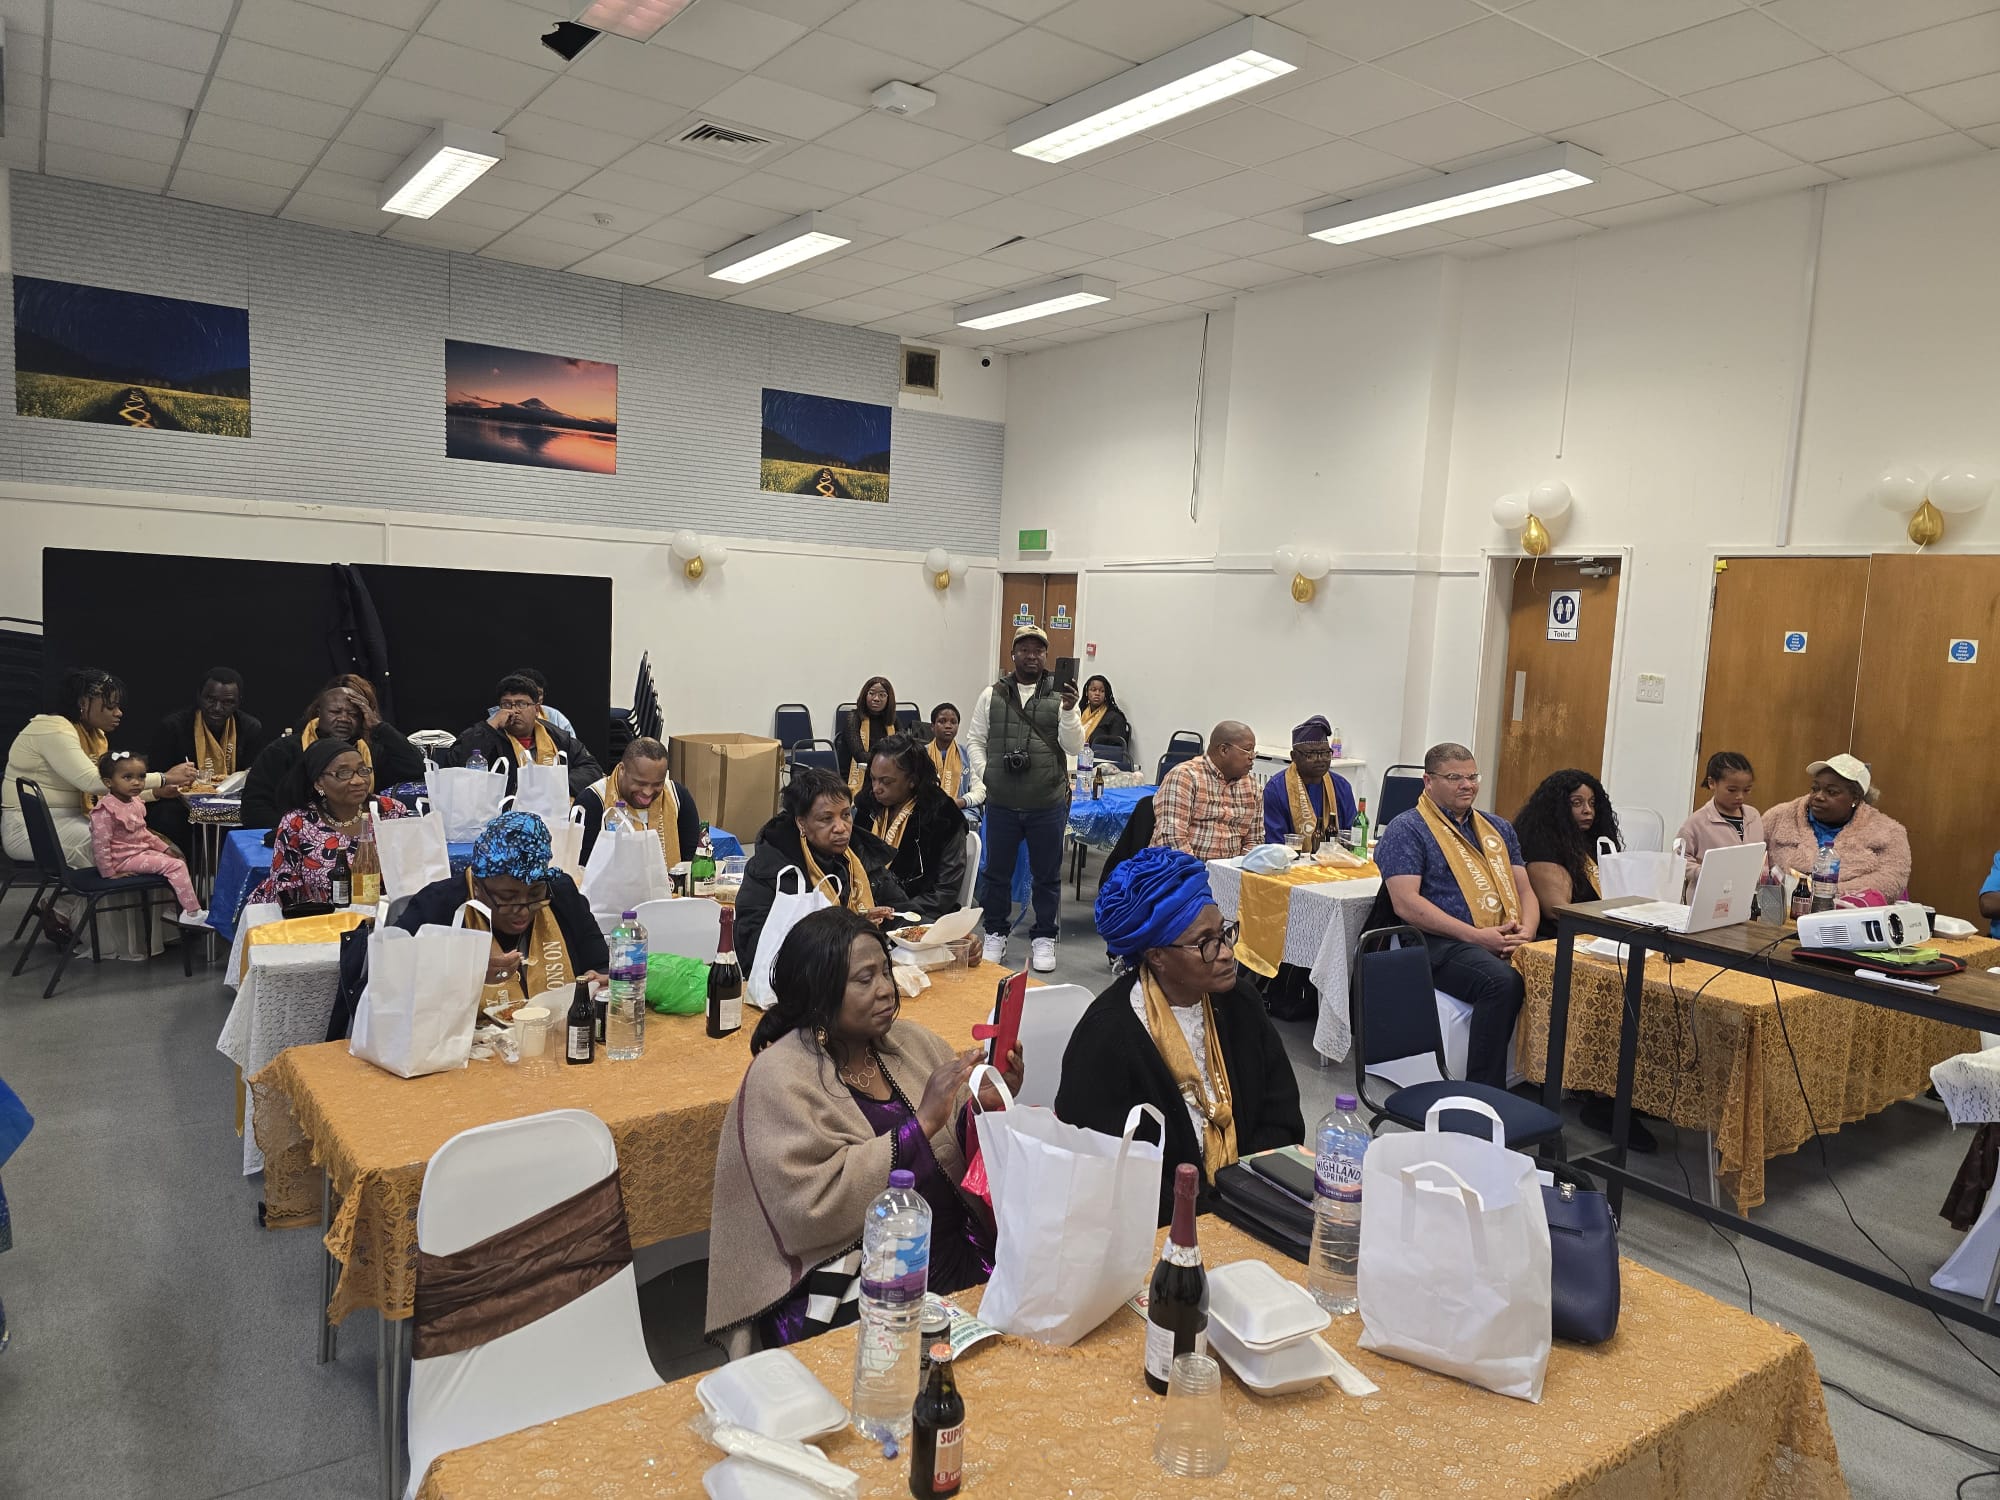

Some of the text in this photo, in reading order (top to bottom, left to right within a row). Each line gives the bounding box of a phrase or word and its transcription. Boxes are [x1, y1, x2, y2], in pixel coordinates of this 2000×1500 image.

[1553, 630, 1571, 638] Toilet
[542, 941, 565, 990] ONS ON
[1316, 1160, 1361, 1181] HIGHLAND
[1323, 1171, 1349, 1184] SPRING
